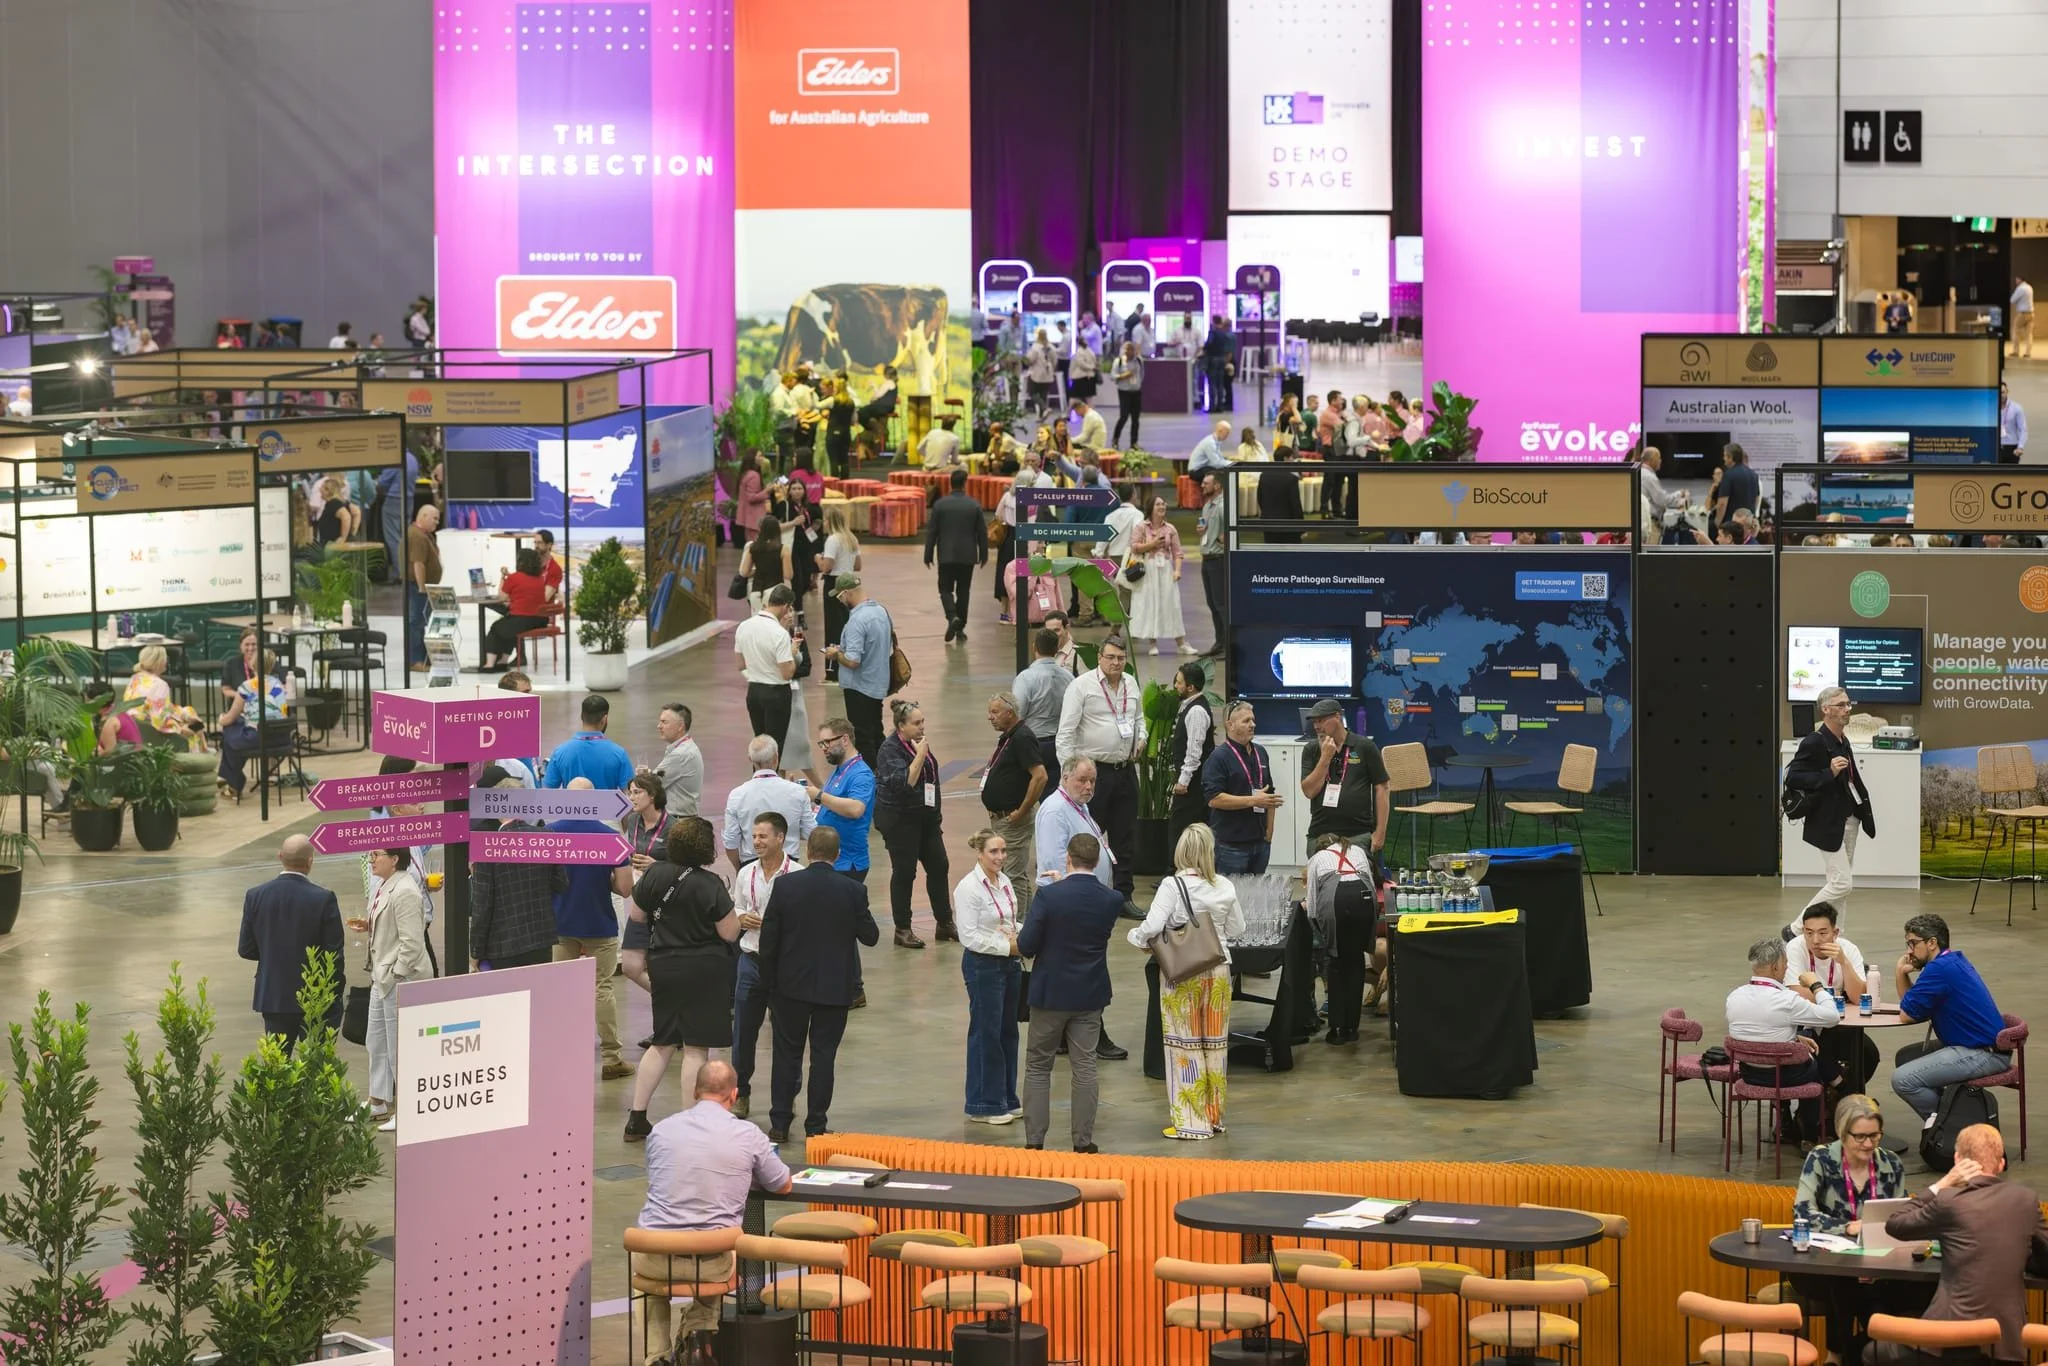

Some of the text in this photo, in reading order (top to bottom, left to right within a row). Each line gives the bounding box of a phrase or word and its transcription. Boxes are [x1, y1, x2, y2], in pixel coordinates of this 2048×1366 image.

[806, 57, 892, 86] Elders
[769, 110, 929, 127] for Australian Agriculture
[554, 124, 616, 145] THE
[1273, 147, 1348, 163] DEMO
[457, 155, 714, 176] INTERSECTION
[1268, 171, 1353, 187] STAGE
[529, 253, 642, 261] BROUGHT TO YOU BY
[510, 291, 664, 340] Elders
[407, 405, 432, 414] NSW
[1669, 400, 1791, 414] Australian Wool.
[1473, 487, 1548, 504] BioScout
[1993, 514, 2038, 522] FUTURE
[1252, 575, 1385, 585] Airborne Pathogen Surveillance
[1933, 632, 2046, 653] Manage you
[1933, 655, 2001, 673] people,
[1932, 676, 2048, 695] connectivity
[1933, 697, 2034, 710] with GrowData.
[444, 709, 530, 723] MEETING POINT
[480, 726, 496, 748] D
[337, 778, 442, 795] BREAKOUT ROOM 2
[348, 794, 380, 802] CONNECT
[396, 789, 442, 798] COLLABORATE
[485, 793, 509, 802] RSM
[485, 805, 598, 815] BUSINESS LOUNGE
[337, 821, 442, 838] BREAKOUT ROOM 3
[348, 837, 380, 846] CONNECT
[396, 832, 442, 841] COLLABORATE
[485, 837, 572, 847] LUCAS GROUP
[485, 848, 607, 859] CHARGING STATION
[441, 1034, 481, 1057] RSM
[417, 1065, 507, 1093] BUSINESS
[417, 1088, 495, 1114] LOUNGE
